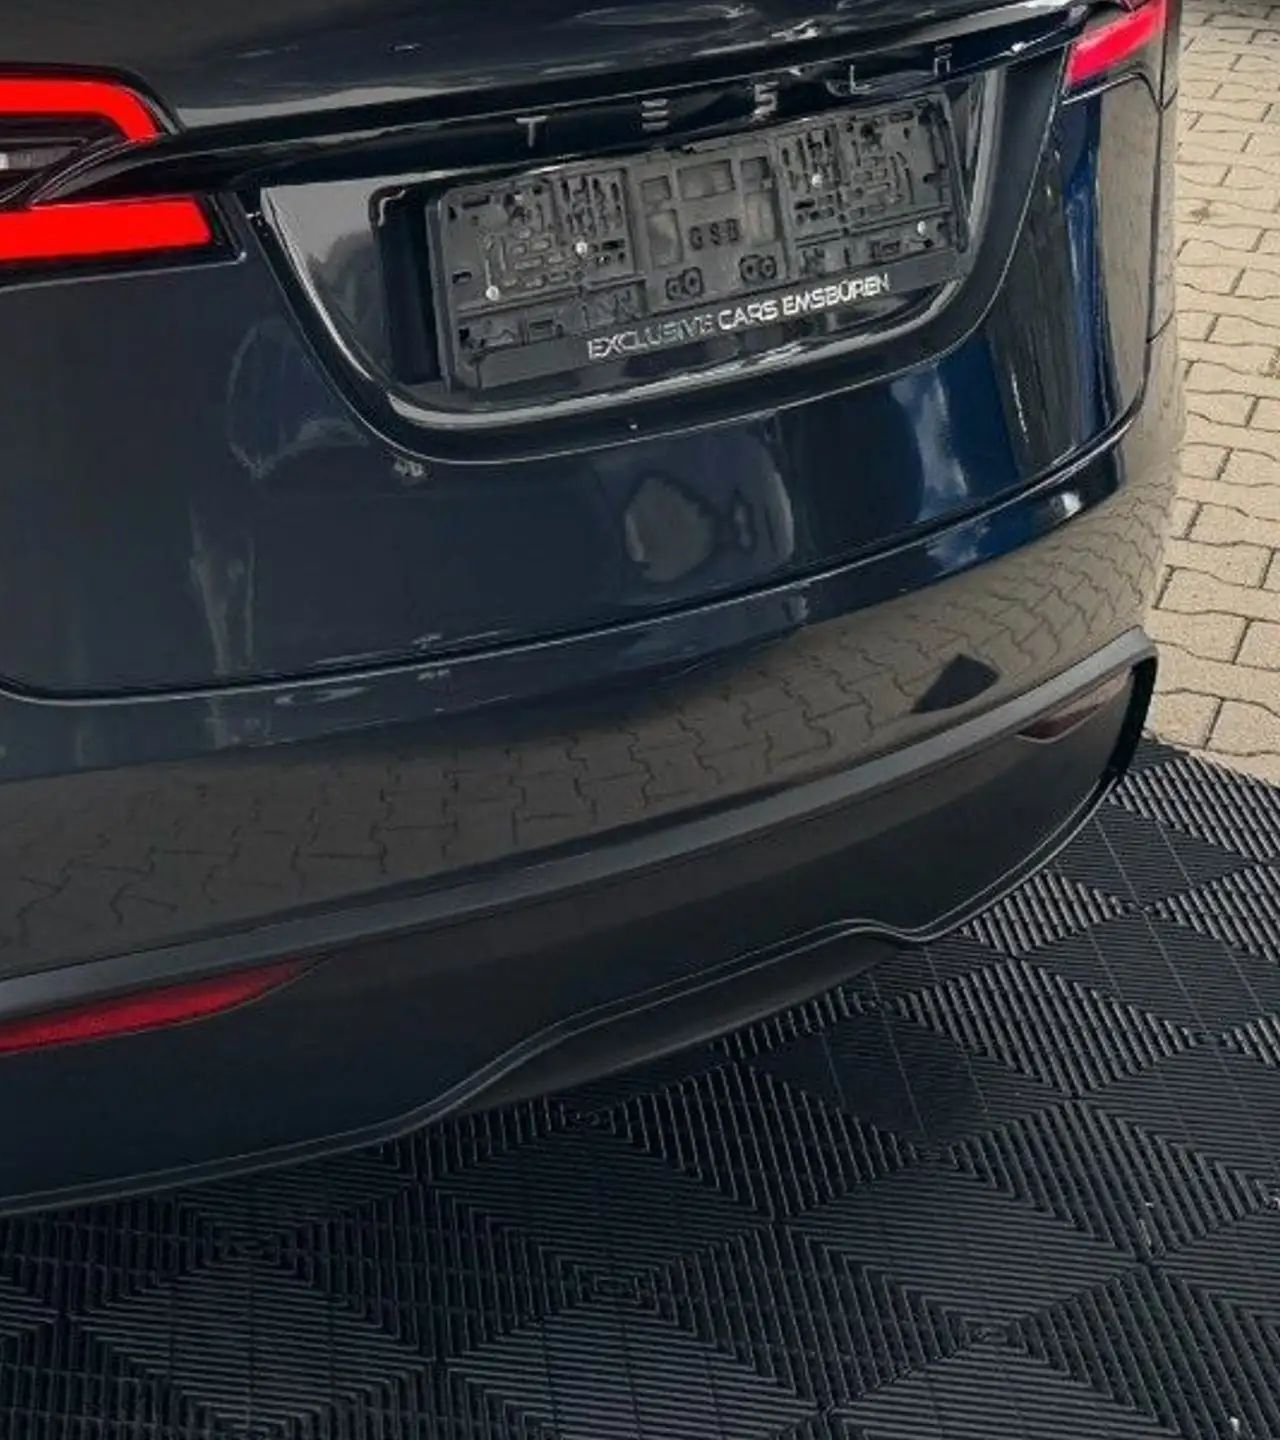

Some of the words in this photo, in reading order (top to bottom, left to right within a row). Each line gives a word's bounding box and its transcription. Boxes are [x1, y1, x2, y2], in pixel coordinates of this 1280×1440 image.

[515, 43, 953, 148] TESLA
[586, 312, 715, 360] EXCLUSIVE
[717, 298, 779, 331] CARS
